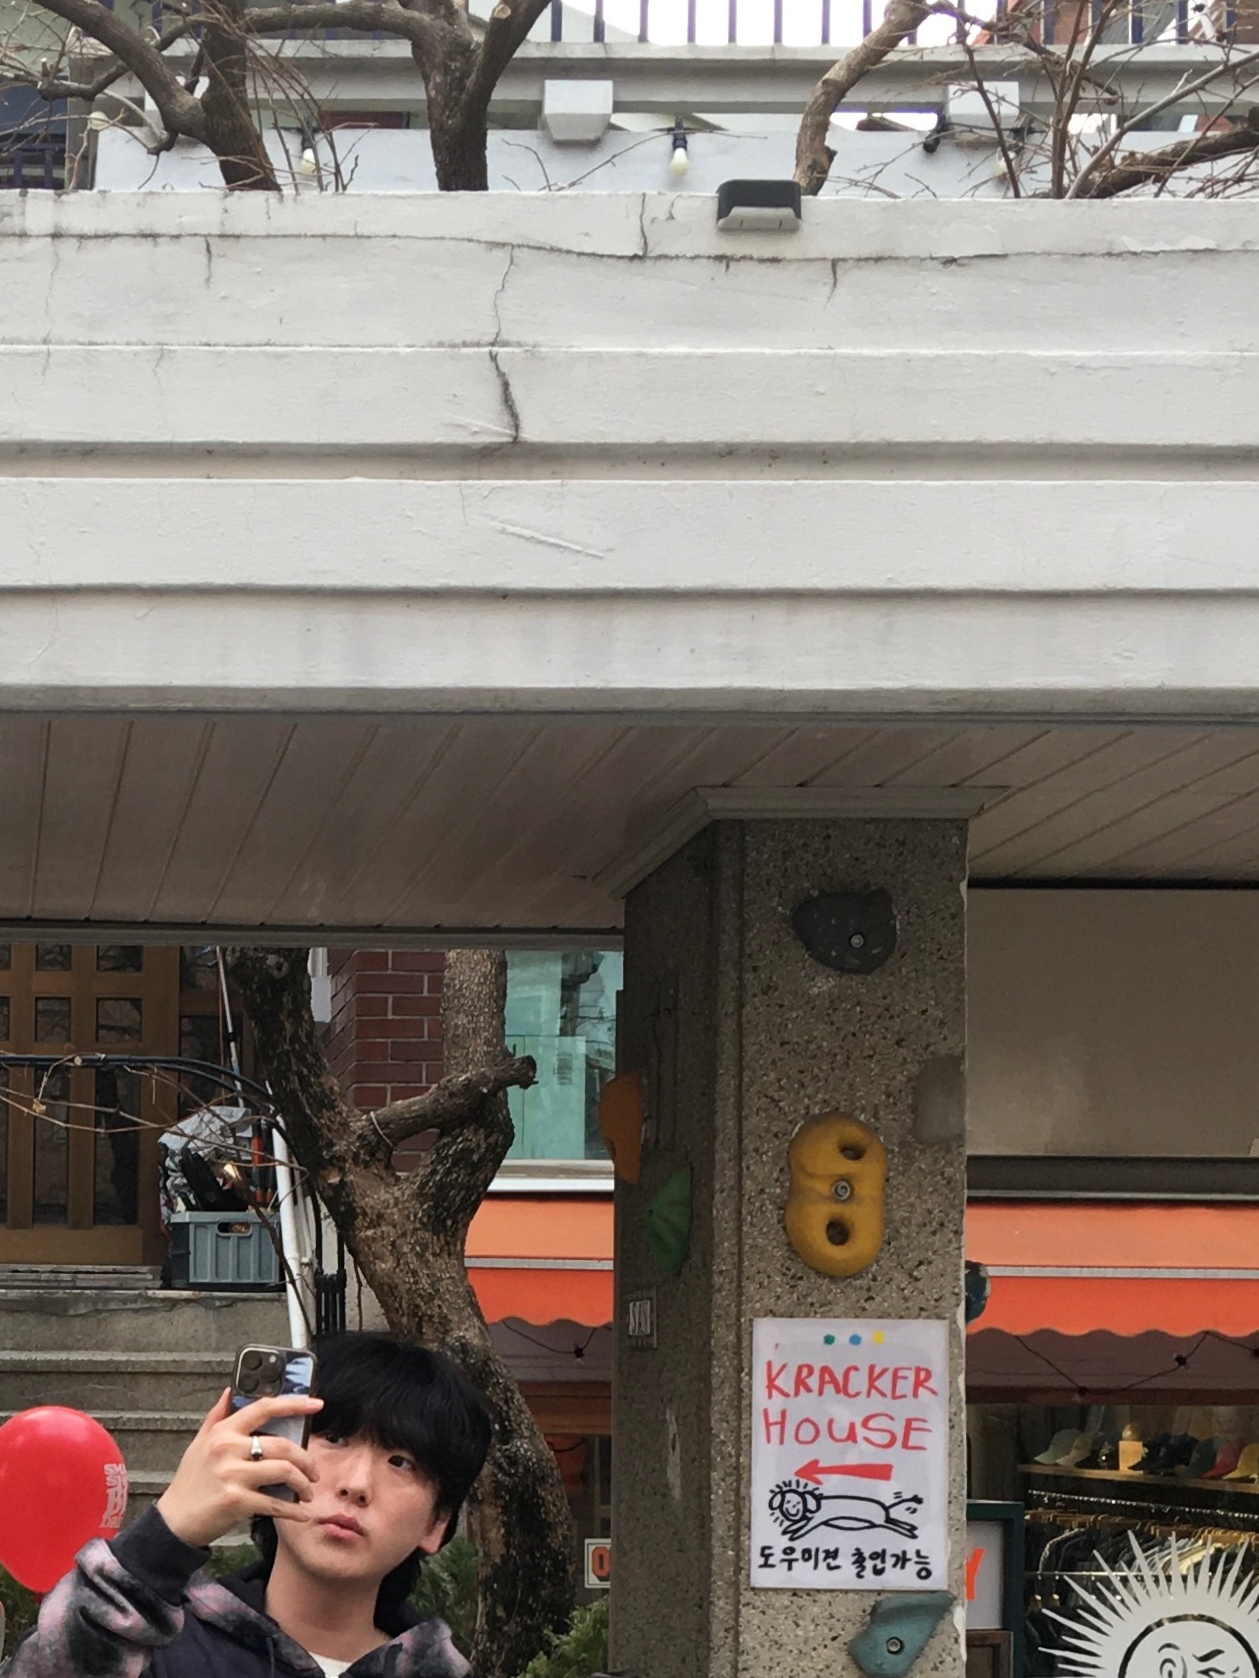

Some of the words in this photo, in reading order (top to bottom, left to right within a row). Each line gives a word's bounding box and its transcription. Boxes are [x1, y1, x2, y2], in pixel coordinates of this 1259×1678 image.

[765, 1360, 939, 1400] KRACKER
[762, 1407, 933, 1451] HOUSE
[757, 1545, 843, 1572] 도우미견
